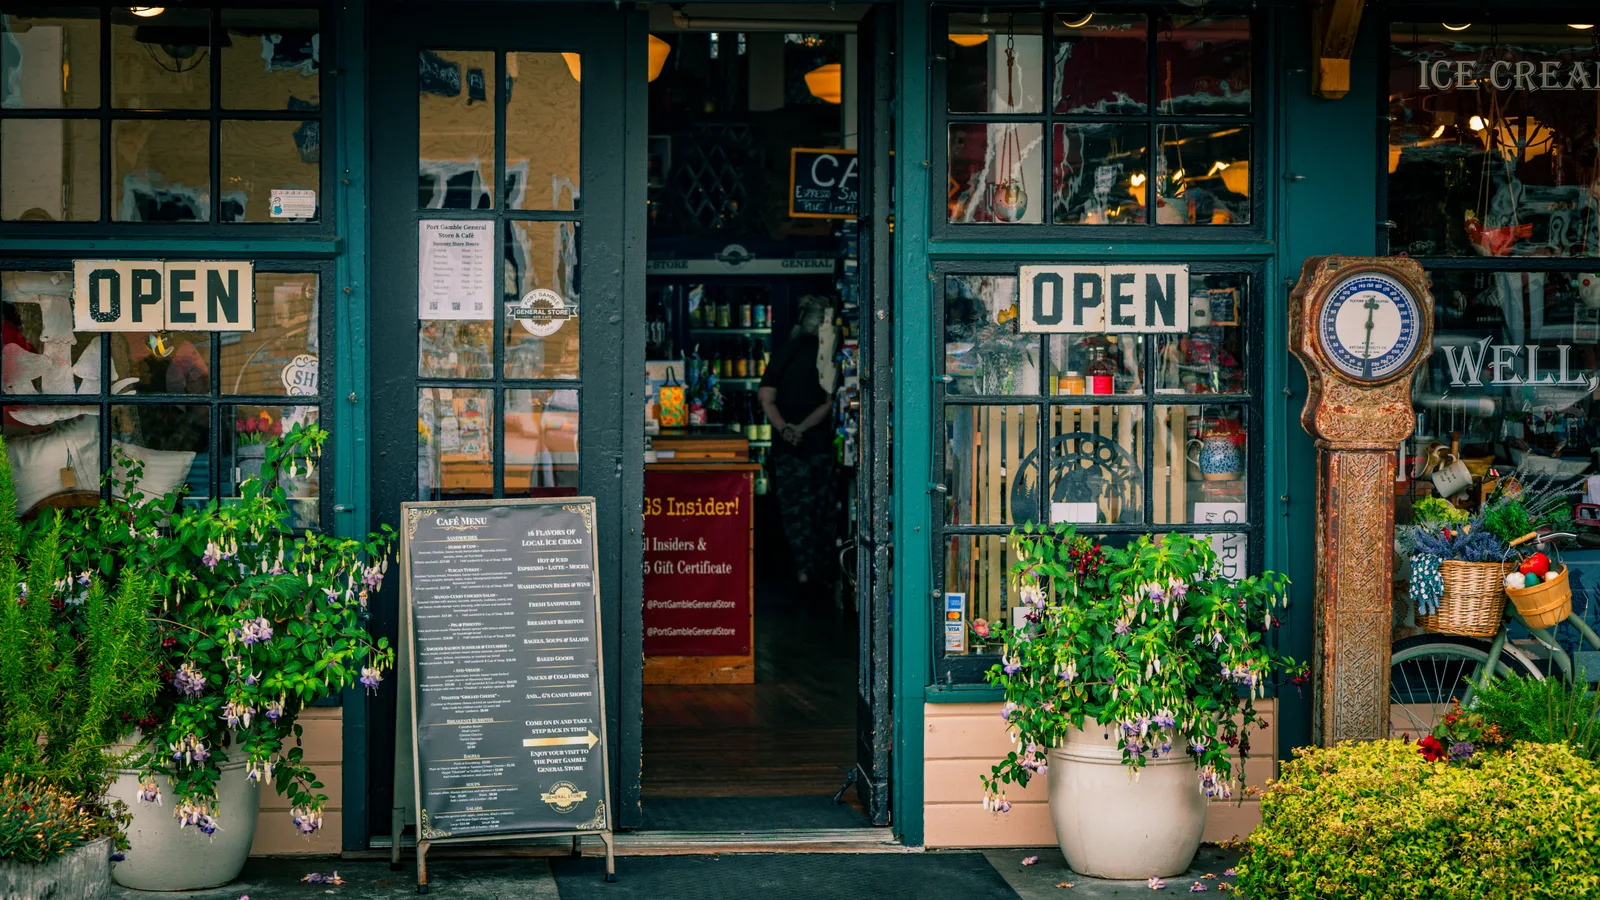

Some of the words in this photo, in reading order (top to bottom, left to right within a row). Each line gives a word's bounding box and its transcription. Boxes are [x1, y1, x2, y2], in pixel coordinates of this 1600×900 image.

[1419, 60, 1479, 90] ICE
[781, 259, 832, 268] GENERAL
[89, 268, 239, 323] OPEN
[1032, 272, 1176, 326] OPEN
[1440, 335, 1599, 393] WELL,
[666, 496, 740, 515] Insider!
[436, 516, 459, 526] CAFÉ
[460, 516, 487, 525] MENU
[653, 537, 694, 551] Insiders
[697, 537, 707, 551] &
[1222, 510, 1239, 588] GARD
[654, 560, 674, 574] Gift
[677, 560, 732, 574] Certificate
[647, 600, 735, 609] @PortGambleGeneralStore
[647, 627, 735, 636] @PortGambleGeneralStore
